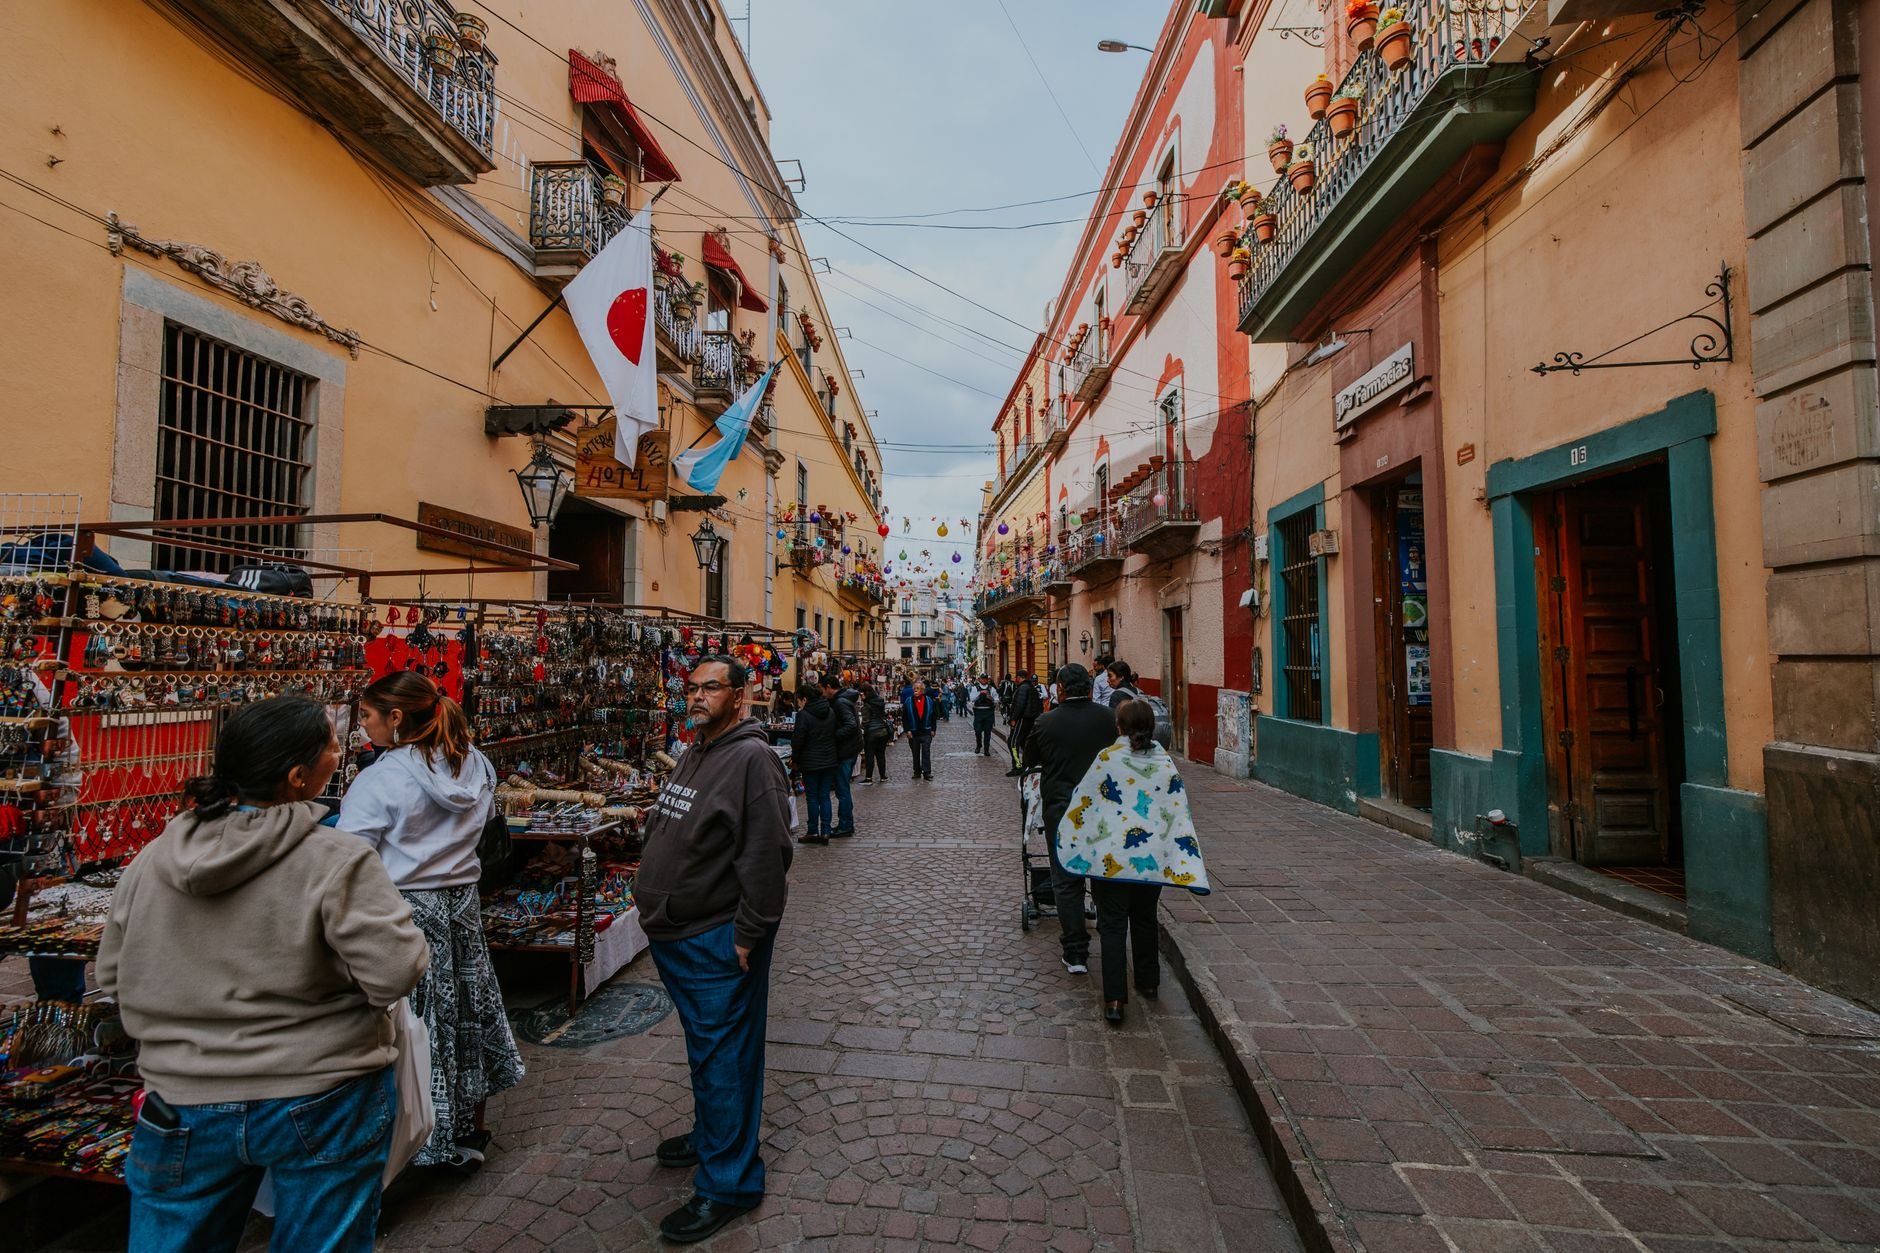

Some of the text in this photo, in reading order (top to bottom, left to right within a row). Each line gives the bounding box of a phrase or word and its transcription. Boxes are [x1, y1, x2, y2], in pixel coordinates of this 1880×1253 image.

[1355, 357, 1412, 407] Farmacias
[1571, 446, 1586, 465] 16
[586, 466, 650, 492] HOTEL
